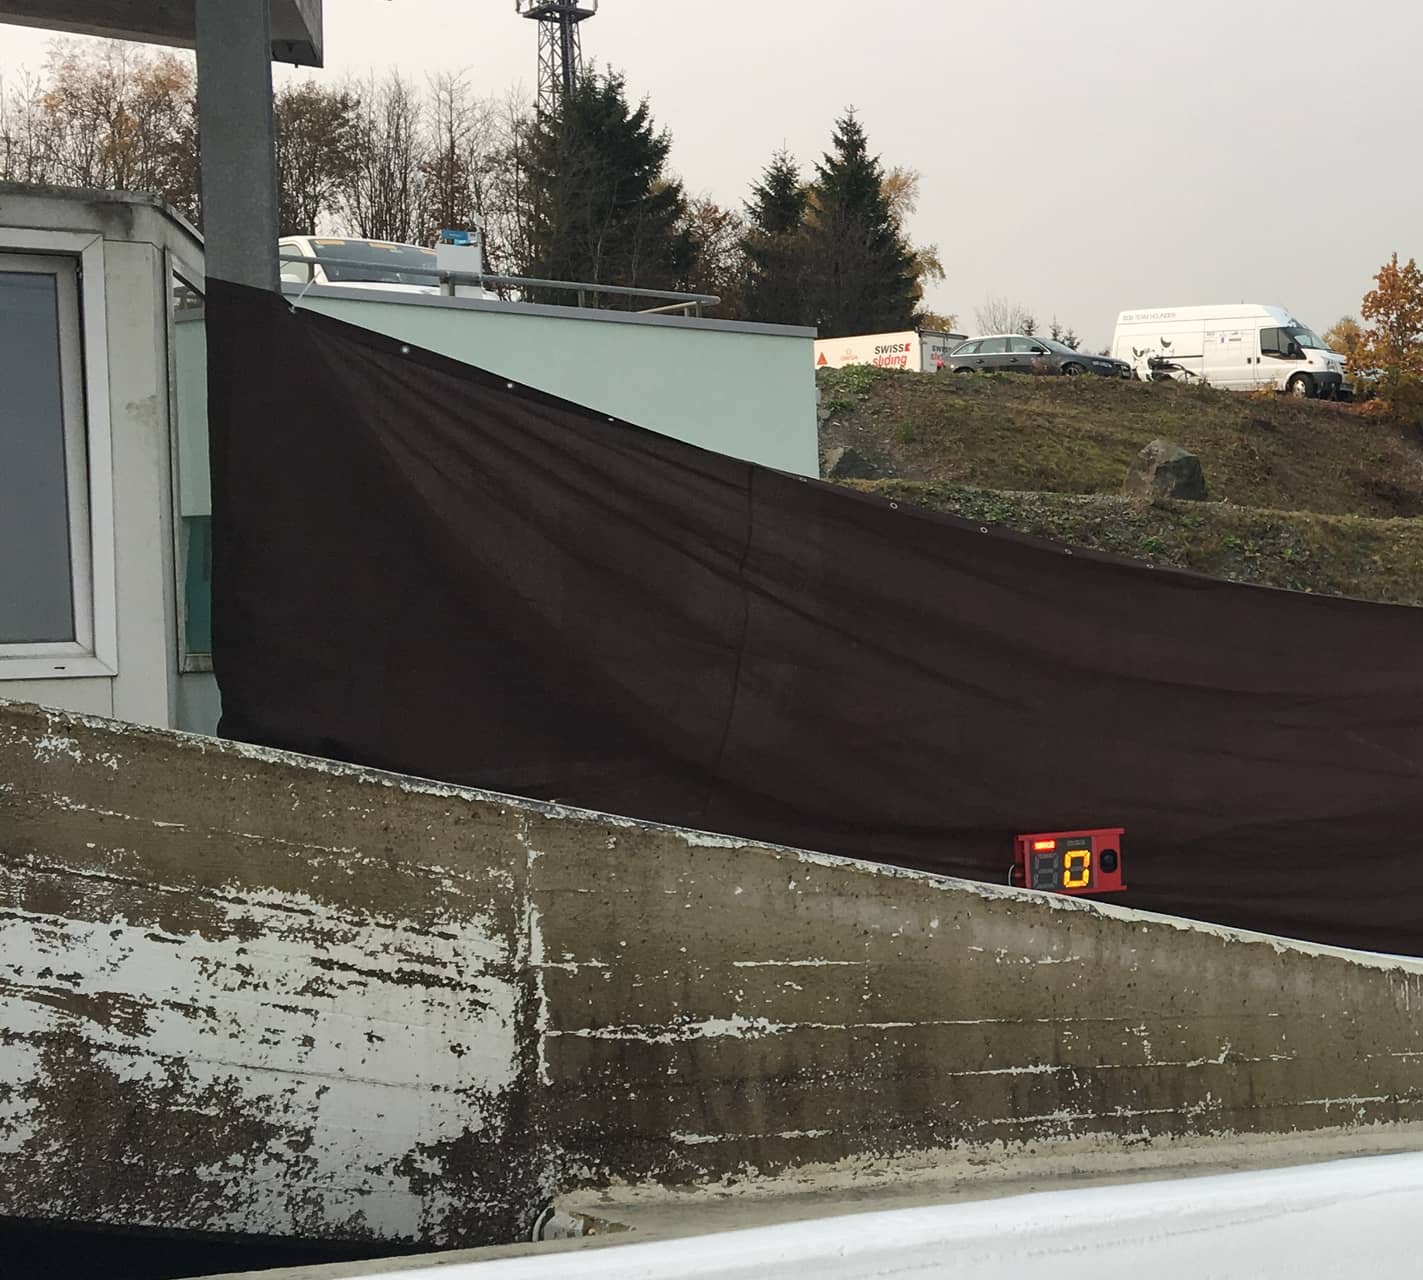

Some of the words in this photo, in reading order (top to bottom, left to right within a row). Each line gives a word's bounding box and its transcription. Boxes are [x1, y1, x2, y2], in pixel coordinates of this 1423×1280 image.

[874, 343, 905, 355] SWISS
[872, 354, 907, 368] sliding
[1064, 850, 1091, 888] 0
